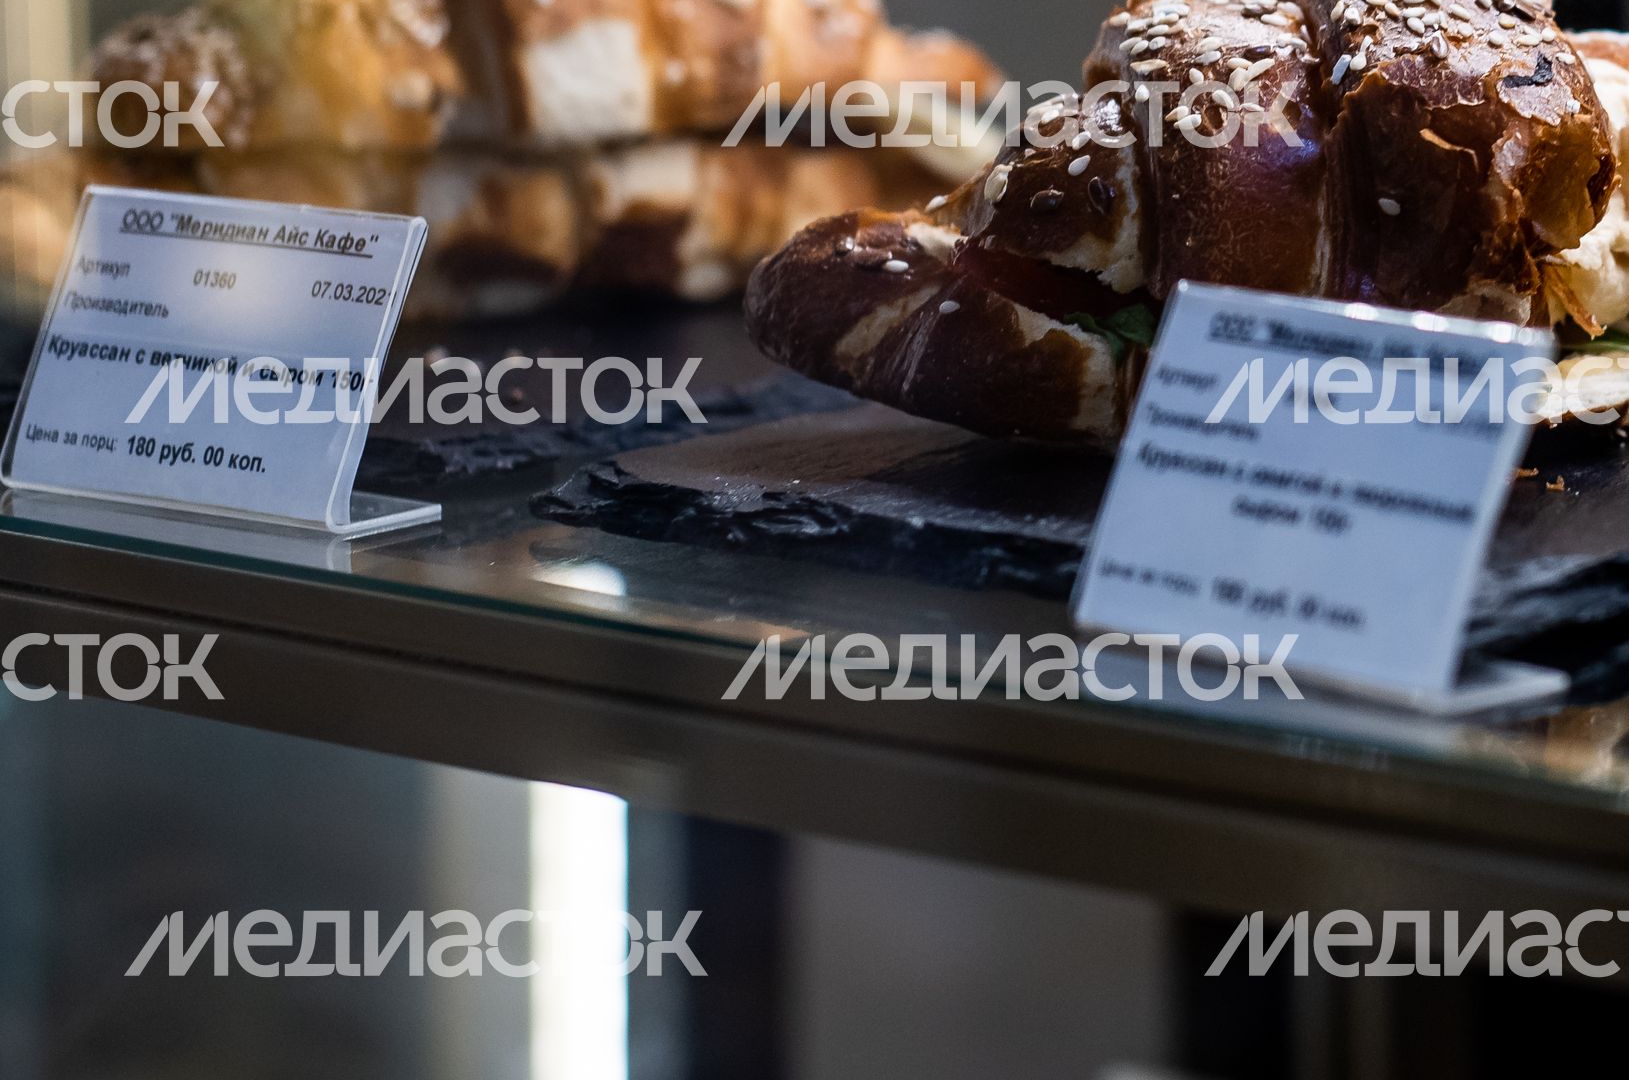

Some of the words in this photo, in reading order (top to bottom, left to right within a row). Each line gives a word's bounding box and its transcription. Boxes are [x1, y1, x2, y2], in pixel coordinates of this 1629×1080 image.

[122, 208, 165, 232] ООО
[273, 223, 309, 247] Айс
[314, 228, 379, 254] Кафе"
[78, 255, 131, 279] Артикул
[193, 269, 237, 290] 01360
[64, 290, 169, 318] Производитель
[47, 333, 131, 362] Круассан
[135, 348, 146, 365] с
[150, 350, 238, 376] ветчиной
[26, 423, 60, 443] Цена
[63, 431, 78, 446] за
[127, 434, 156, 457] 180
[158, 442, 196, 466] руб.
[203, 445, 225, 467] 00
[228, 452, 267, 473] коп.
